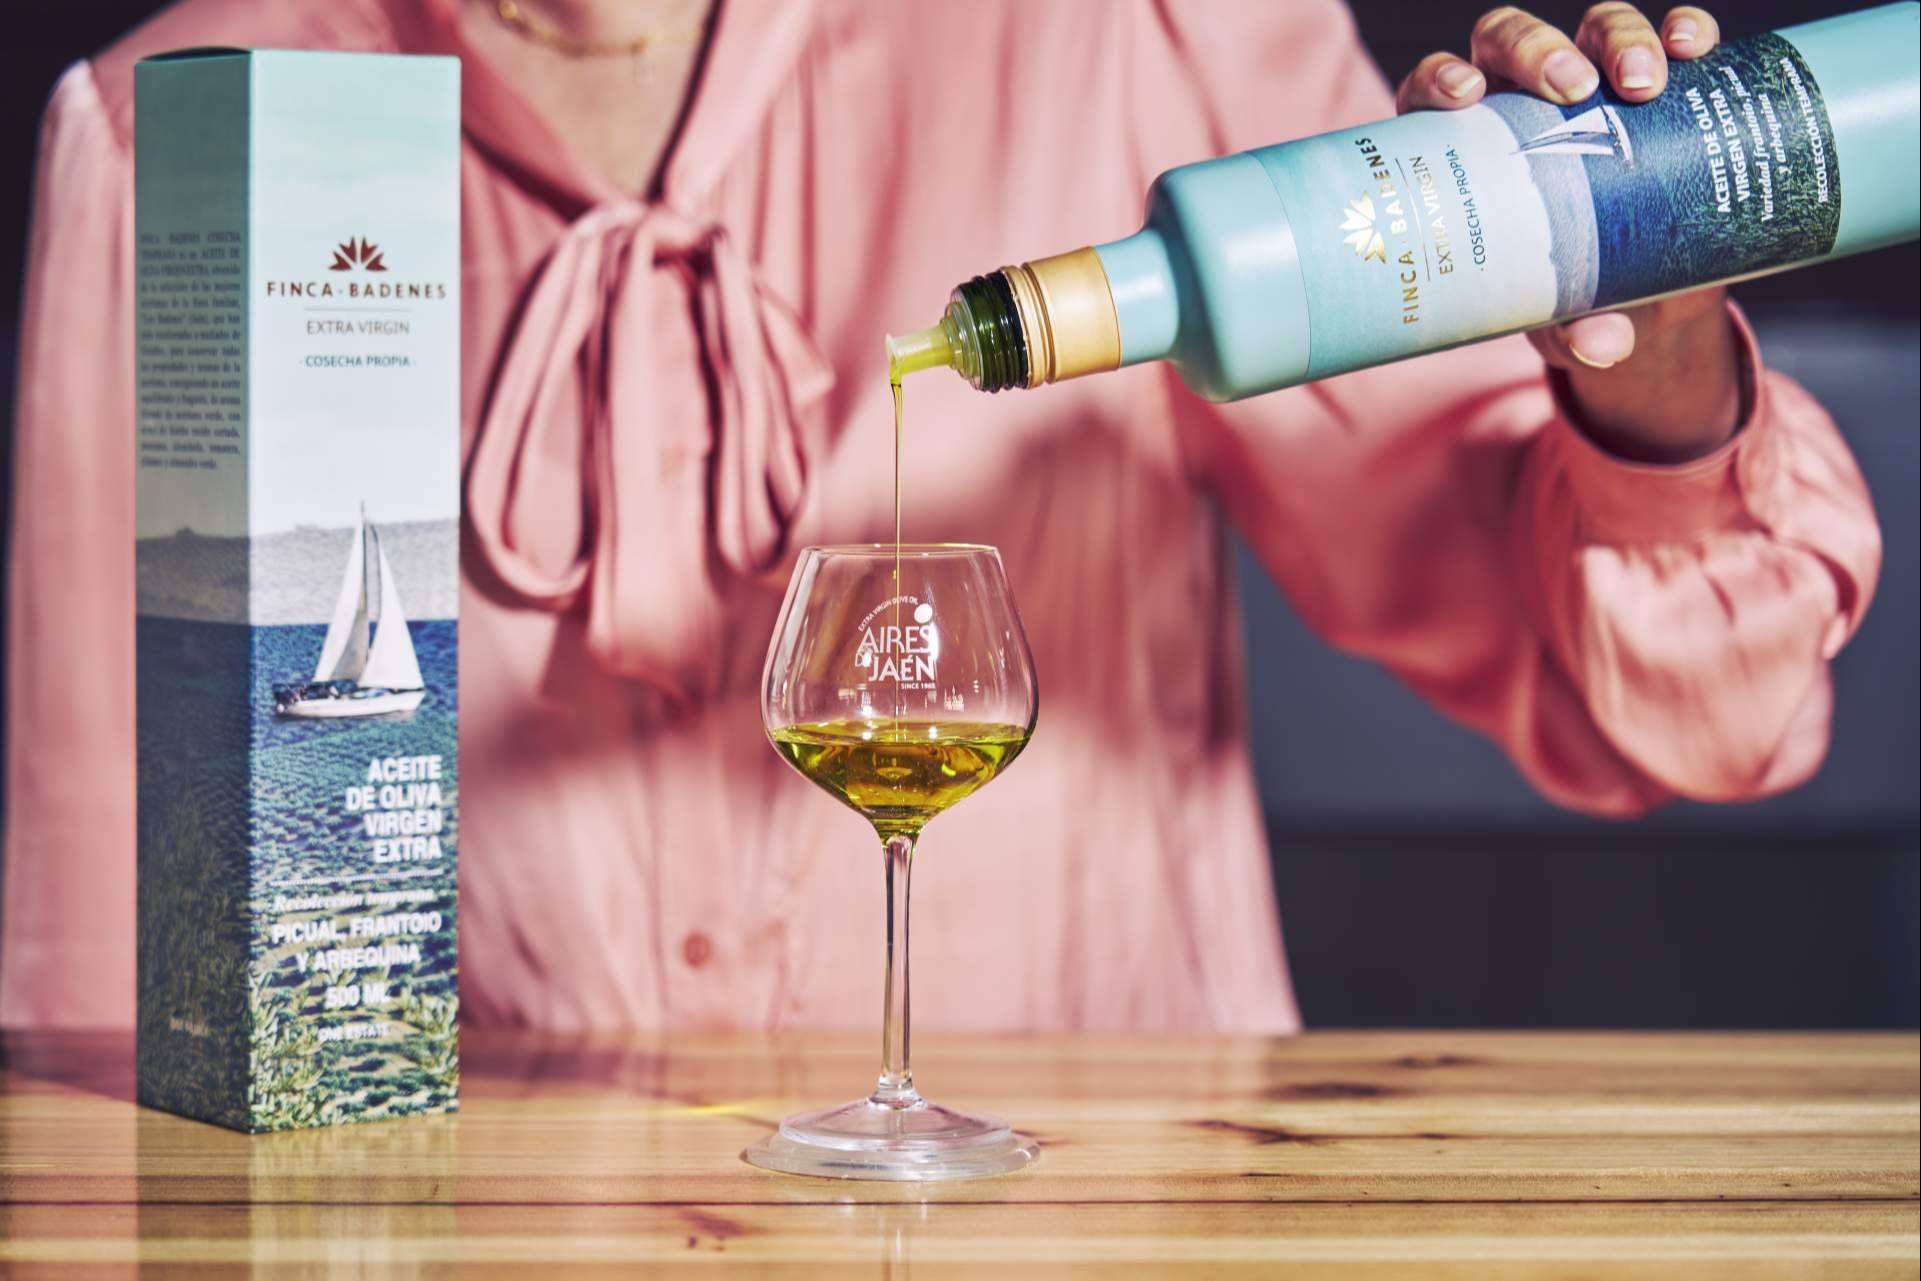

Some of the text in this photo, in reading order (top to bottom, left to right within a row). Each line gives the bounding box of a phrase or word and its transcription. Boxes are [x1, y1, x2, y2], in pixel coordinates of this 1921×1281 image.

[1718, 66, 1751, 99] picual
[1709, 88, 1751, 202] VIRGEN EXTRA
[1758, 93, 1792, 176] y arbequina
[1685, 87, 1731, 214] ACEITE DE OLIVA
[1755, 160, 1774, 222] Variedad
[1409, 155, 1454, 275] EXTRA VIRGIN
[1445, 148, 1487, 265] COSECHA PROPIA
[1355, 137, 1420, 325] FINCA BADENES
[267, 281, 447, 299] FINCA BADENES
[306, 320, 411, 335] EXTRA VIRGIN
[305, 355, 411, 368] COSECHA PROPIA
[856, 624, 934, 654] AIRES
[868, 655, 936, 682] JAÉN
[367, 754, 443, 783] ACEITE
[345, 781, 443, 811] DE OLIVA
[363, 808, 443, 837] VIRGEN
[373, 836, 443, 863] EXTRA
[350, 910, 443, 939] FRANTOIO
[295, 943, 422, 974] Y ARBEQUINA
[324, 984, 360, 1010] 500
